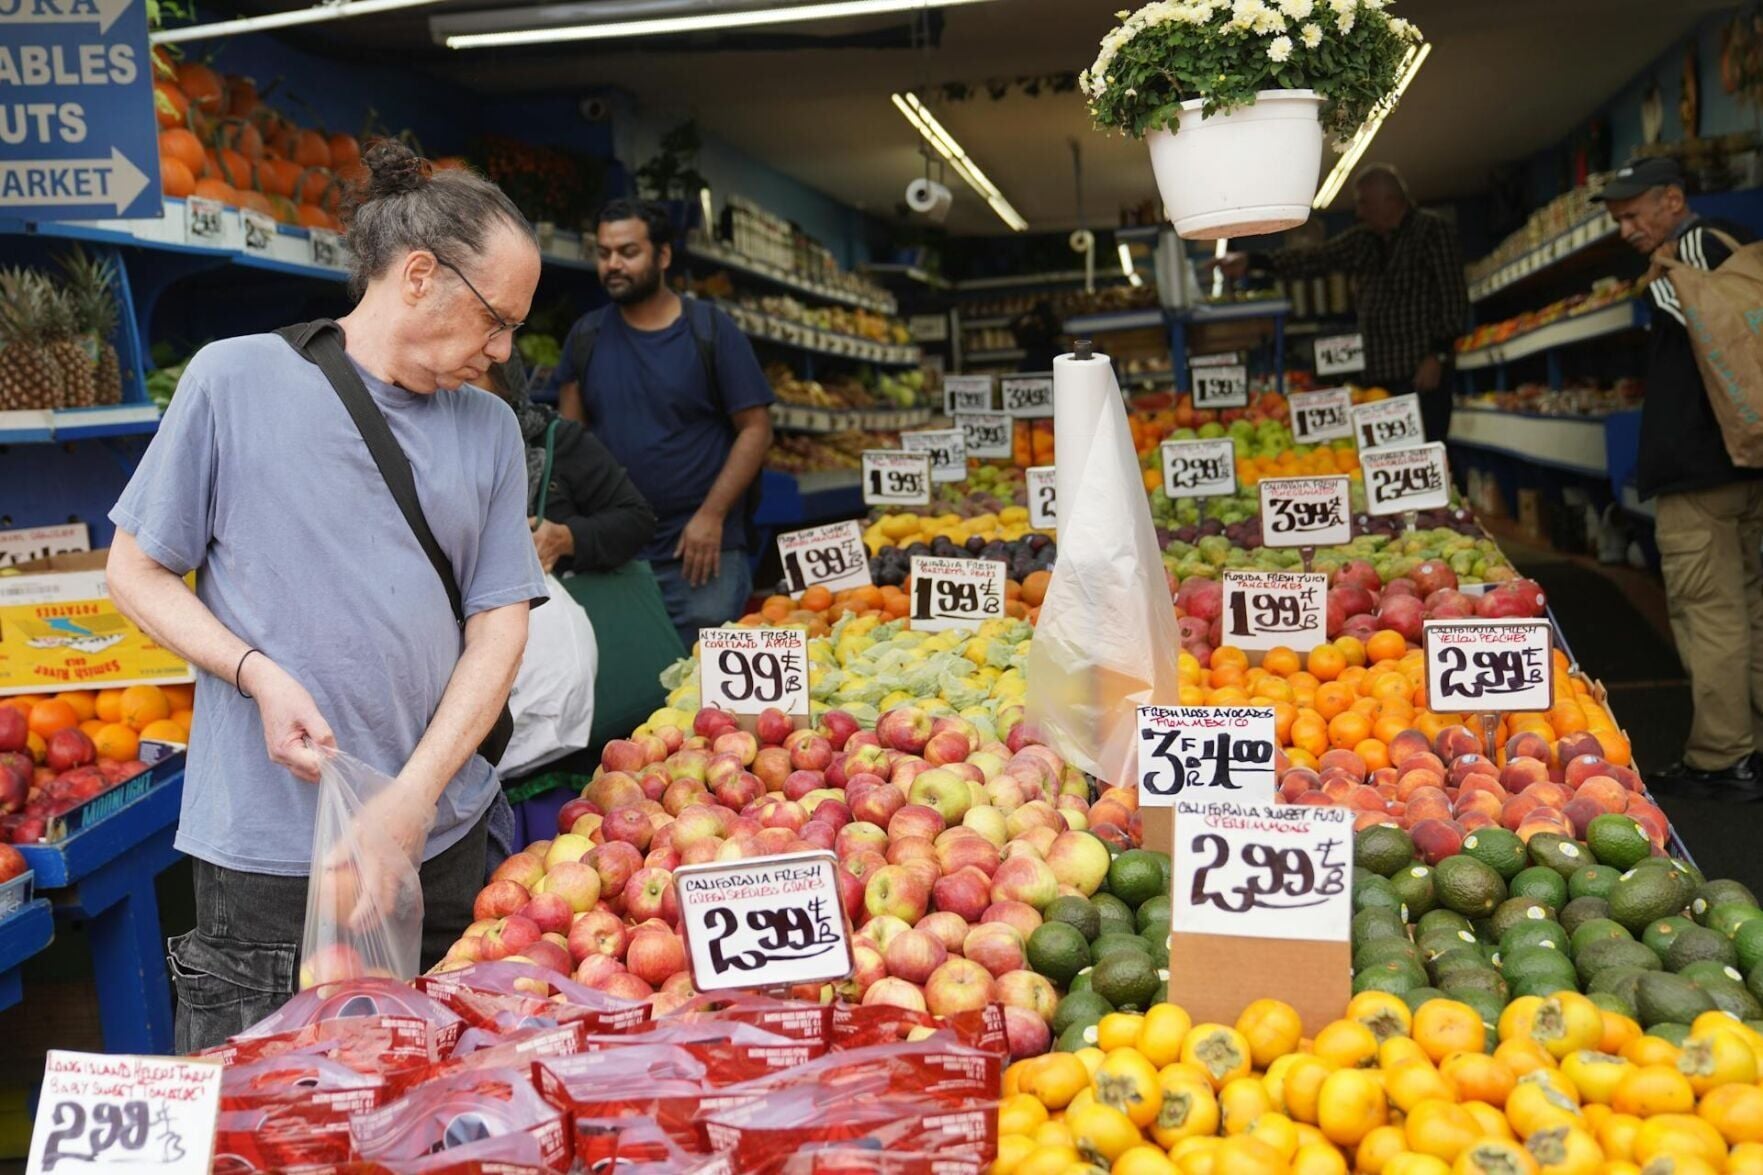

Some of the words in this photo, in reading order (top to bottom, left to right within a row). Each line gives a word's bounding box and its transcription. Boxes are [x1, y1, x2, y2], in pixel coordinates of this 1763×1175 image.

[0, 102, 87, 144] UTS
[2, 168, 112, 197] ARKET
[1269, 498, 1330, 533] 399
[785, 546, 846, 593] 199
[1224, 572, 1263, 582] FLORIDA
[1267, 573, 1294, 582] FRESH
[1236, 580, 1303, 590] TANGERINES
[911, 577, 979, 620] 199
[1229, 591, 1301, 636] 199
[705, 640, 758, 649] CORTLAND
[761, 630, 797, 640] FRESH
[1438, 634, 1476, 643] YELLOW
[1480, 633, 1527, 643] PEACHES
[718, 649, 783, 702] 99
[1437, 646, 1525, 698] 299
[1137, 707, 1179, 718] FRESH
[1213, 708, 1274, 719] AVOCADOS
[1192, 719, 1249, 728] MEXICO
[1141, 728, 1185, 795] 3
[1178, 801, 1261, 818] CALIFORNIA
[1264, 807, 1311, 821] SWEET
[686, 874, 771, 892] CALIFORNIA
[775, 865, 821, 881] FRESH
[1191, 834, 1315, 912] 299
[689, 888, 726, 904] GREEN
[704, 907, 815, 975] 299
[42, 1101, 149, 1172] 299
